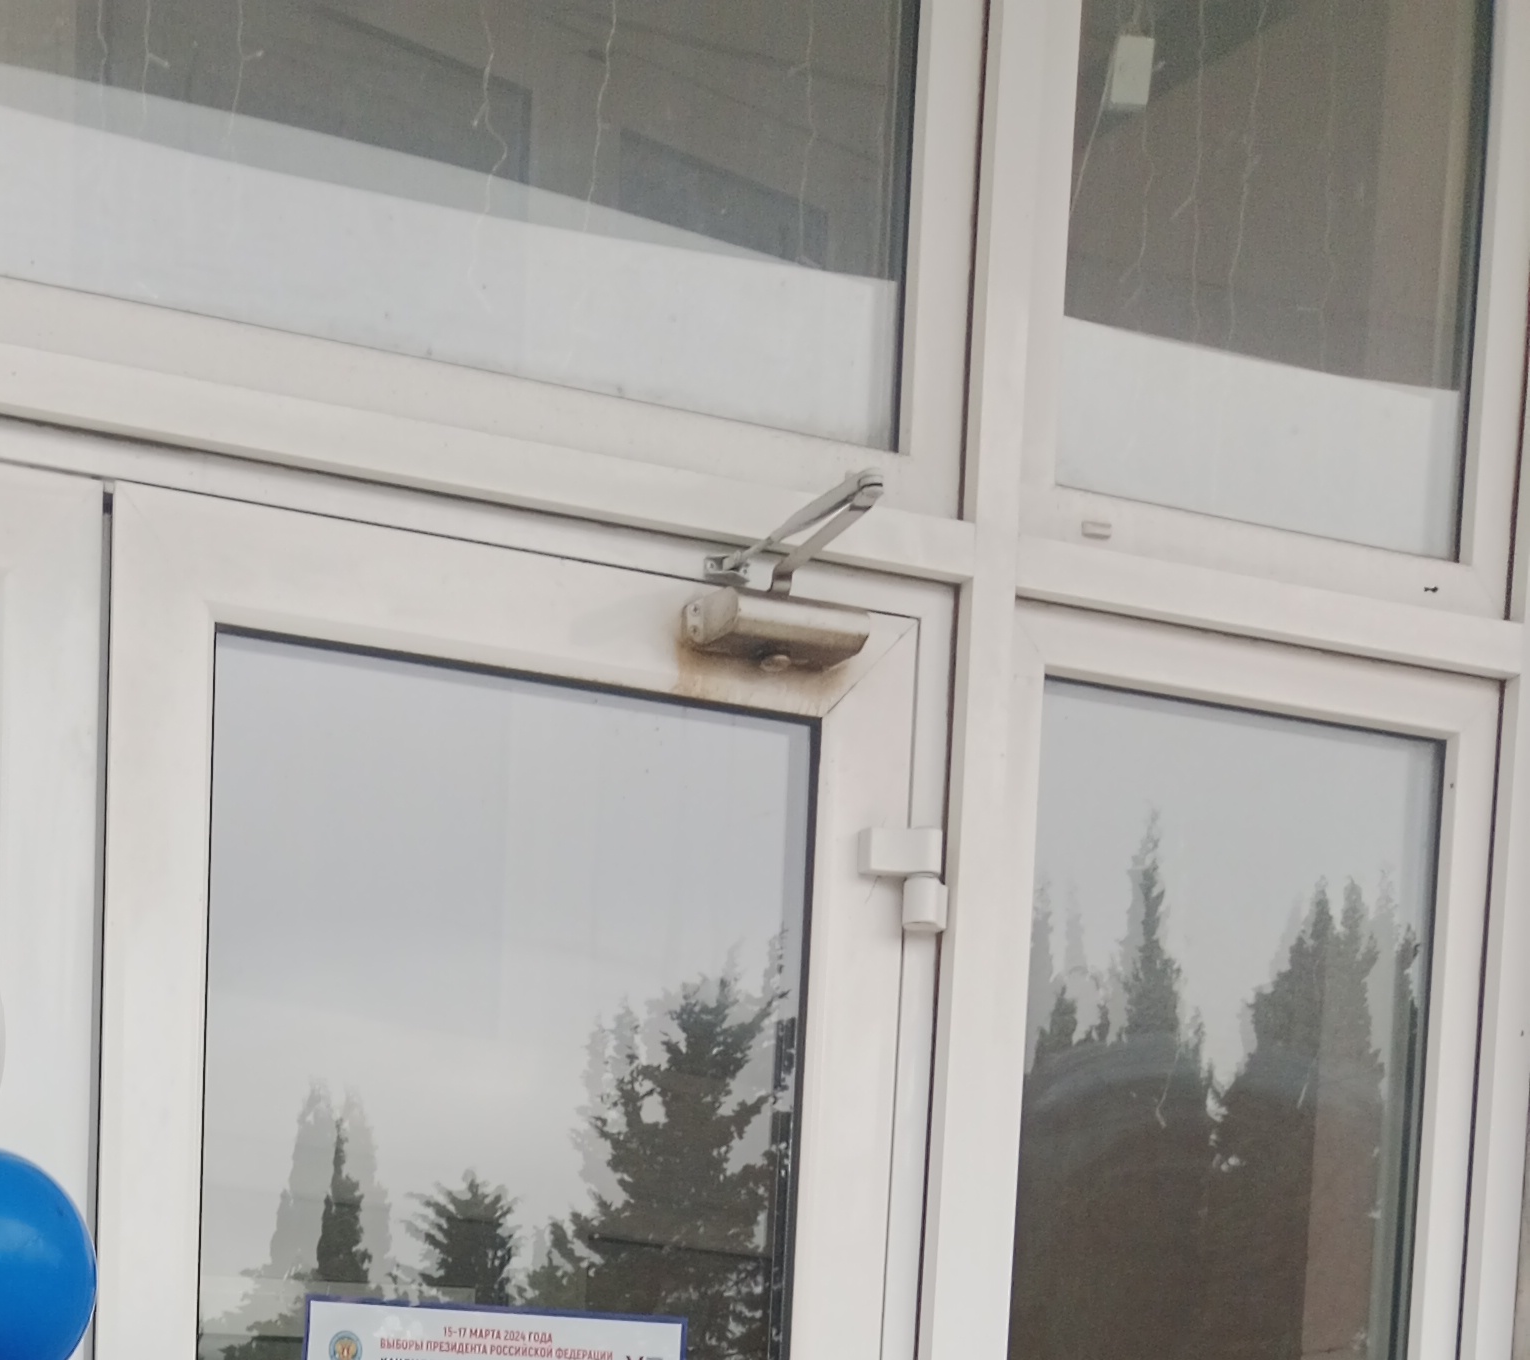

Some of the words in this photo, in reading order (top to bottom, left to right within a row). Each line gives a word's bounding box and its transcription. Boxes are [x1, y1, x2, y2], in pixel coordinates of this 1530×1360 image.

[470, 1328, 501, 1340] МАРТА
[504, 1330, 526, 1341] 2024
[528, 1331, 553, 1344] ГОДА
[380, 1338, 423, 1351] ВЫБОРЫ
[426, 1340, 488, 1355] ПРЕЗИДЕНТА
[490, 1343, 553, 1358] РОССИЙСКОЙ
